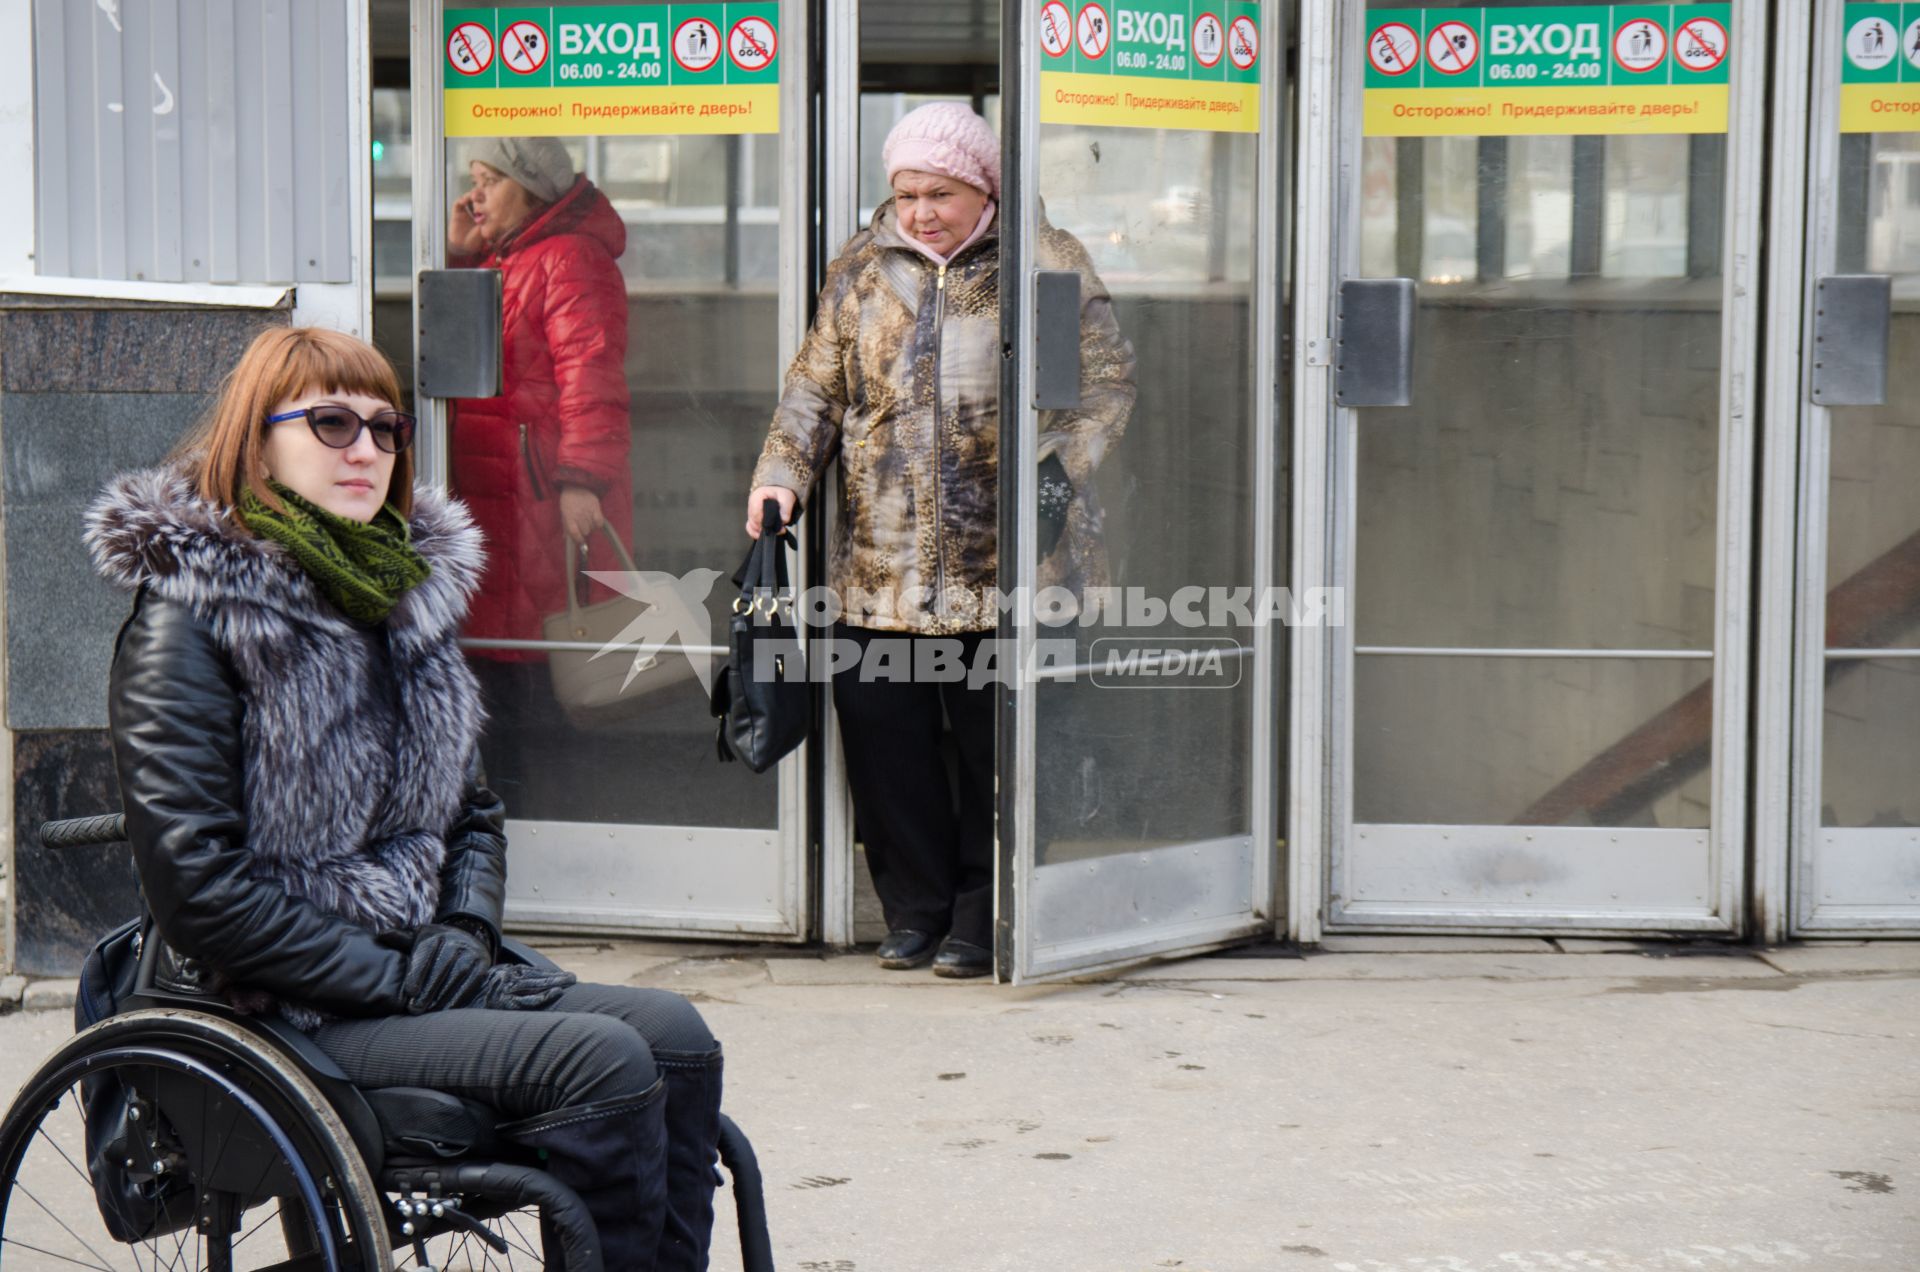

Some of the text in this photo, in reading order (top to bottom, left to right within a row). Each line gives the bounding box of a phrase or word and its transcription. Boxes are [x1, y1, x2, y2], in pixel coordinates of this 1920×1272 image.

[559, 22, 661, 59] ВХОД
[1116, 9, 1186, 52] ВХОД
[1489, 23, 1601, 60] ВХОД
[559, 63, 603, 80] 06.00
[617, 62, 661, 79] 24.00
[1117, 51, 1147, 69] 06.00
[1155, 53, 1186, 71] 24.00
[1489, 63, 1538, 80] 06.00
[1552, 62, 1601, 79] 24.00
[471, 101, 753, 121] Осторожно! Придерживайте дверь!
[1055, 89, 1242, 113] Осторожно! Придерживайте дверь!
[1392, 101, 1699, 120] Осторожно! Придерживайте дверь!
